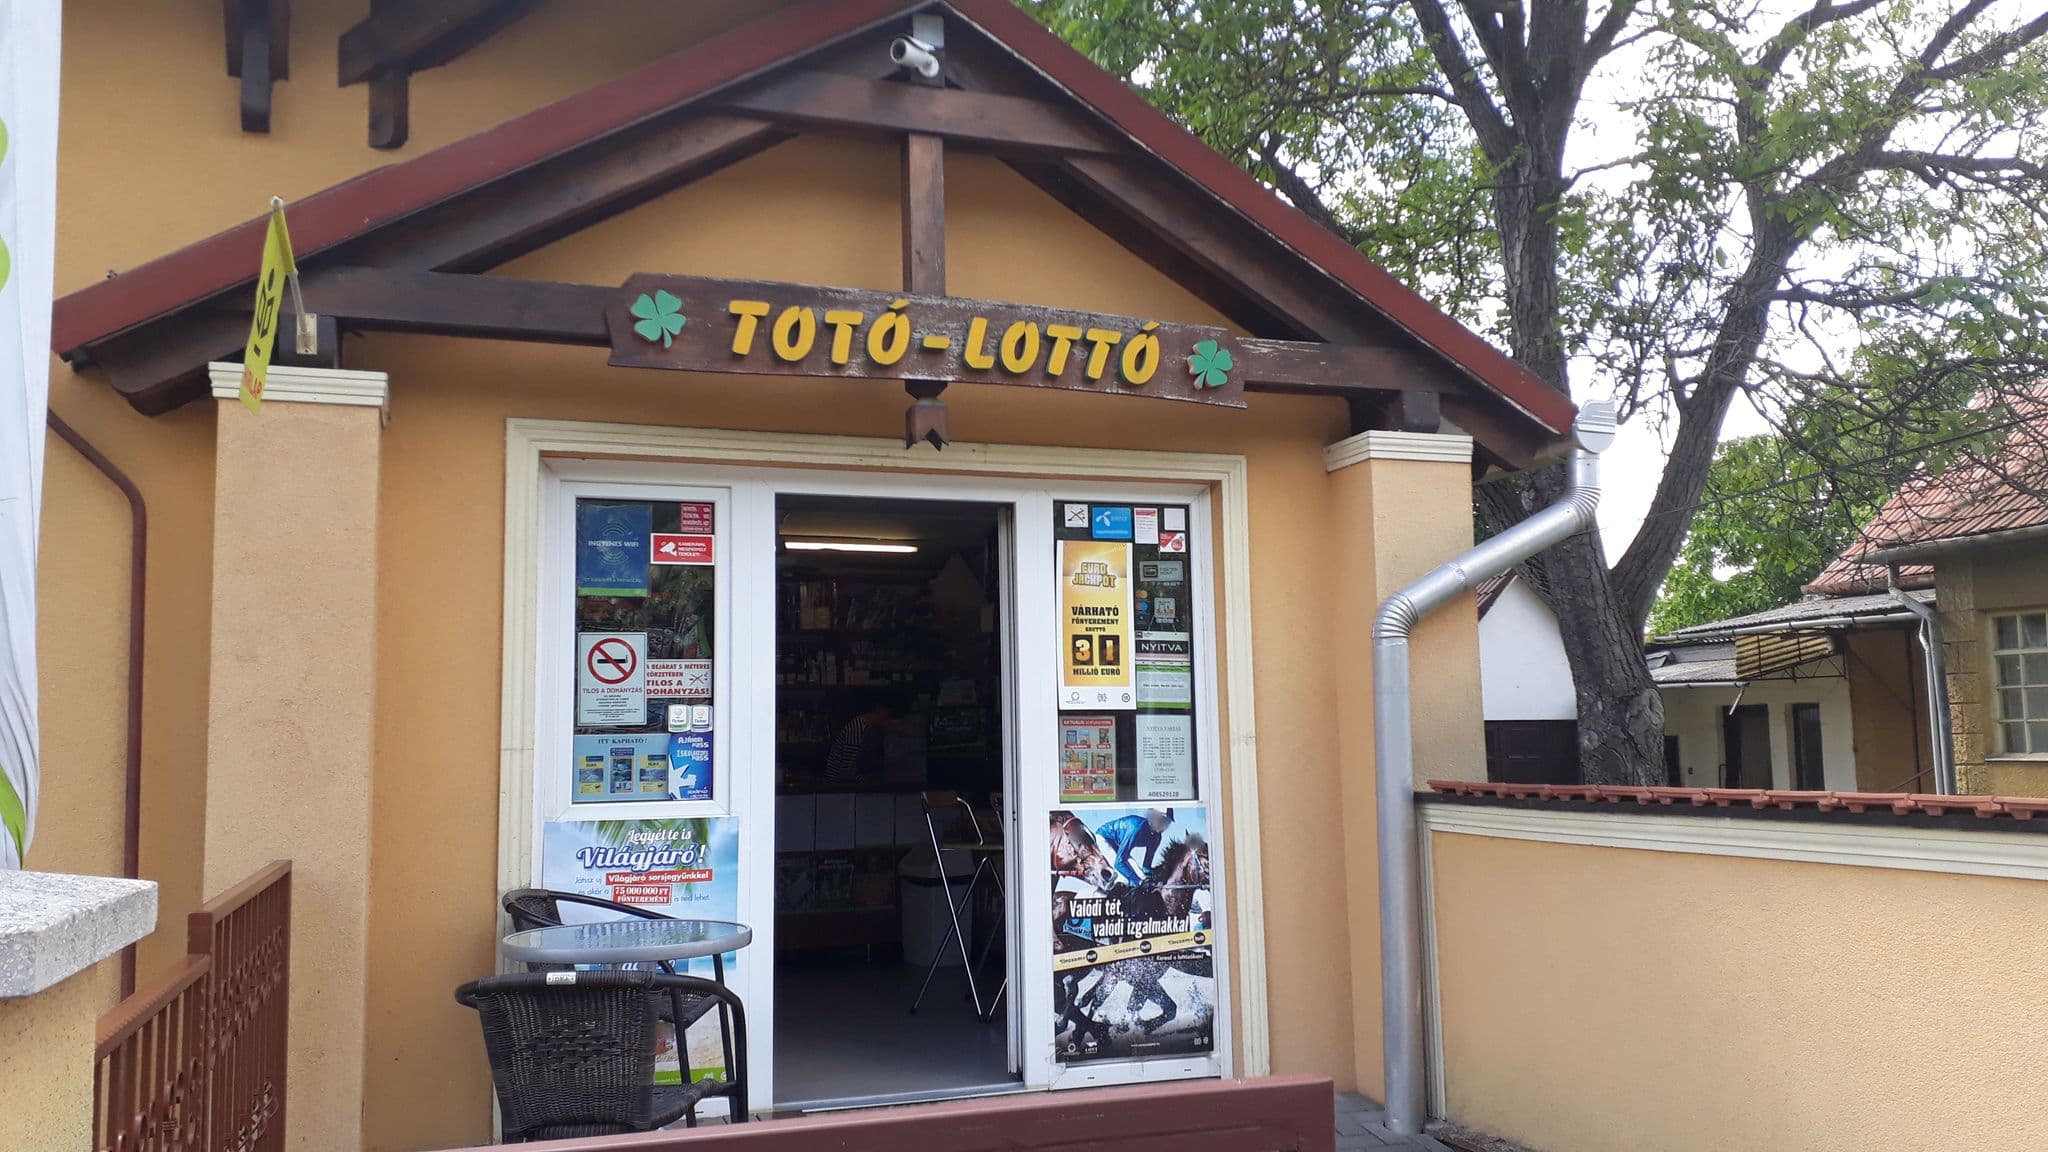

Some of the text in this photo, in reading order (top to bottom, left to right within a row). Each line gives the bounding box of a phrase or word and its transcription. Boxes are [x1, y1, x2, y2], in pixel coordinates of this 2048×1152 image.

[1081, 562, 1108, 574] EURO
[1072, 573, 1117, 588] JACKPOT
[1072, 604, 1119, 616] VÁRHATÓ
[1141, 643, 1183, 652] NYITVA
[1073, 667, 1099, 675] MILLIÓ
[628, 828, 692, 845] Legyél te is
[608, 873, 647, 884] Világjáró
[614, 887, 624, 895] 75
[624, 887, 640, 895] 000
[642, 887, 658, 895] 000
[1069, 898, 1124, 918] Valódi tét,
[1093, 919, 1124, 937] valódi
[1127, 916, 1190, 939] izgalmakkal
